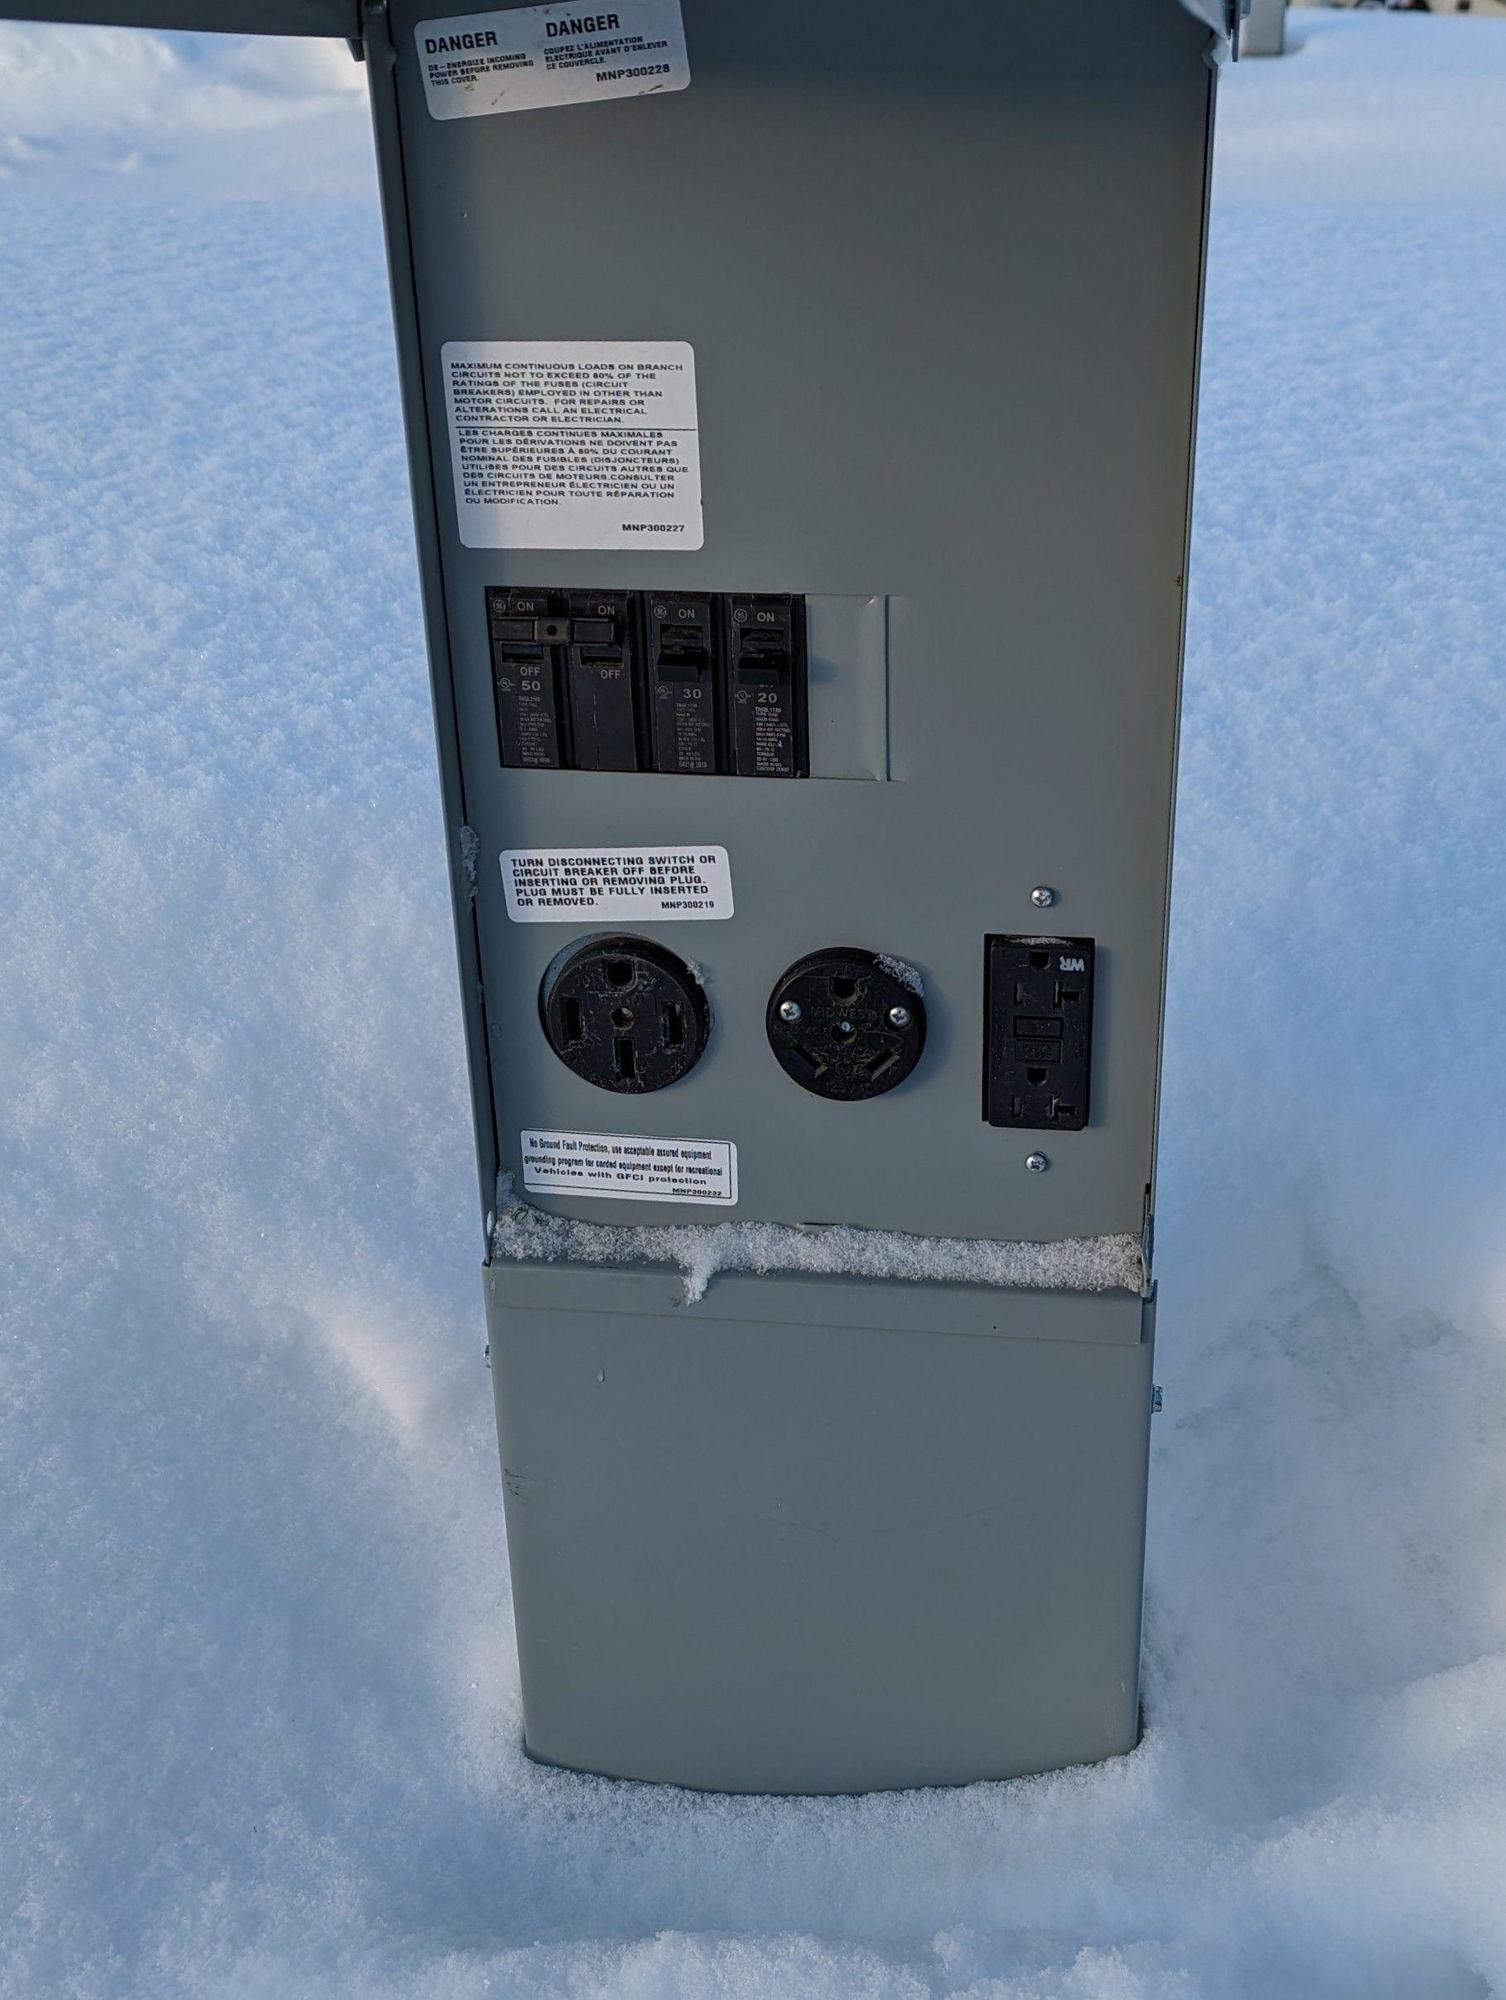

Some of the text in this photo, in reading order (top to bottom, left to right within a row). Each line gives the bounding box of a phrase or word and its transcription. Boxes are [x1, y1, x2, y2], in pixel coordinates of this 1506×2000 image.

[545, 14, 620, 37] DANGER
[425, 31, 498, 54] DANGER
[544, 36, 643, 55] COUPEZ L'ALIMENTATION
[545, 40, 668, 62] ELECTRIQUE AVANT D'ENLEVER
[487, 53, 526, 64] INCOMING
[558, 57, 607, 69] COUVERCLE.
[430, 60, 534, 79] POWER BEFORE REMOVING
[596, 64, 670, 82] MNP300228
[451, 75, 480, 84] COVER.
[618, 363, 634, 371] ON
[451, 371, 501, 379] CIRCUITS
[617, 372, 632, 380] OF
[581, 381, 628, 389] (CIRCUIT
[453, 389, 516, 397] BREAKERS)
[518, 389, 577, 397] EMPLOYED
[633, 390, 663, 398] THAN
[454, 406, 529, 414] ALTERATIONS
[581, 407, 648, 415] ELECTRICAL
[551, 416, 624, 424] ELECTRICIAN.
[536, 430, 598, 438] CONTINUES
[620, 448, 672, 456] COURANT
[590, 457, 680, 465] (DISJONCTEURS)
[620, 465, 663, 473] AUTRES
[487, 472, 536, 480] CIRCUITS
[481, 481, 566, 489] ENTREPRENEUR
[622, 524, 685, 532] MNP300227
[517, 601, 534, 612] ON
[598, 605, 615, 616] ON
[678, 608, 695, 619] ON
[756, 612, 775, 622] ON
[520, 666, 541, 676] OFF
[600, 669, 621, 679] OFF
[521, 680, 541, 691] 50
[683, 688, 702, 699] 30
[757, 692, 777, 703] 20
[511, 855, 716, 867] TURN DISCONNECTING SWITCH OR
[512, 866, 695, 877] CIRCUIT BREAKER OFF BEFORE
[514, 876, 706, 887] INSERTING OR REMOVING PLUG.
[516, 885, 708, 897] PLUG MUST BE FULLY INSERTED
[517, 897, 599, 907] OR REMOVED.
[661, 901, 714, 909] MNP300219
[1059, 956, 1085, 972] WR
[529, 1138, 712, 1160] No Ground Fault Protection, use acceptable assured equipment
[524, 1155, 722, 1176] grounding program for corded equipment except for recreational
[534, 1167, 707, 1185] Vehicles with GFCI protection
